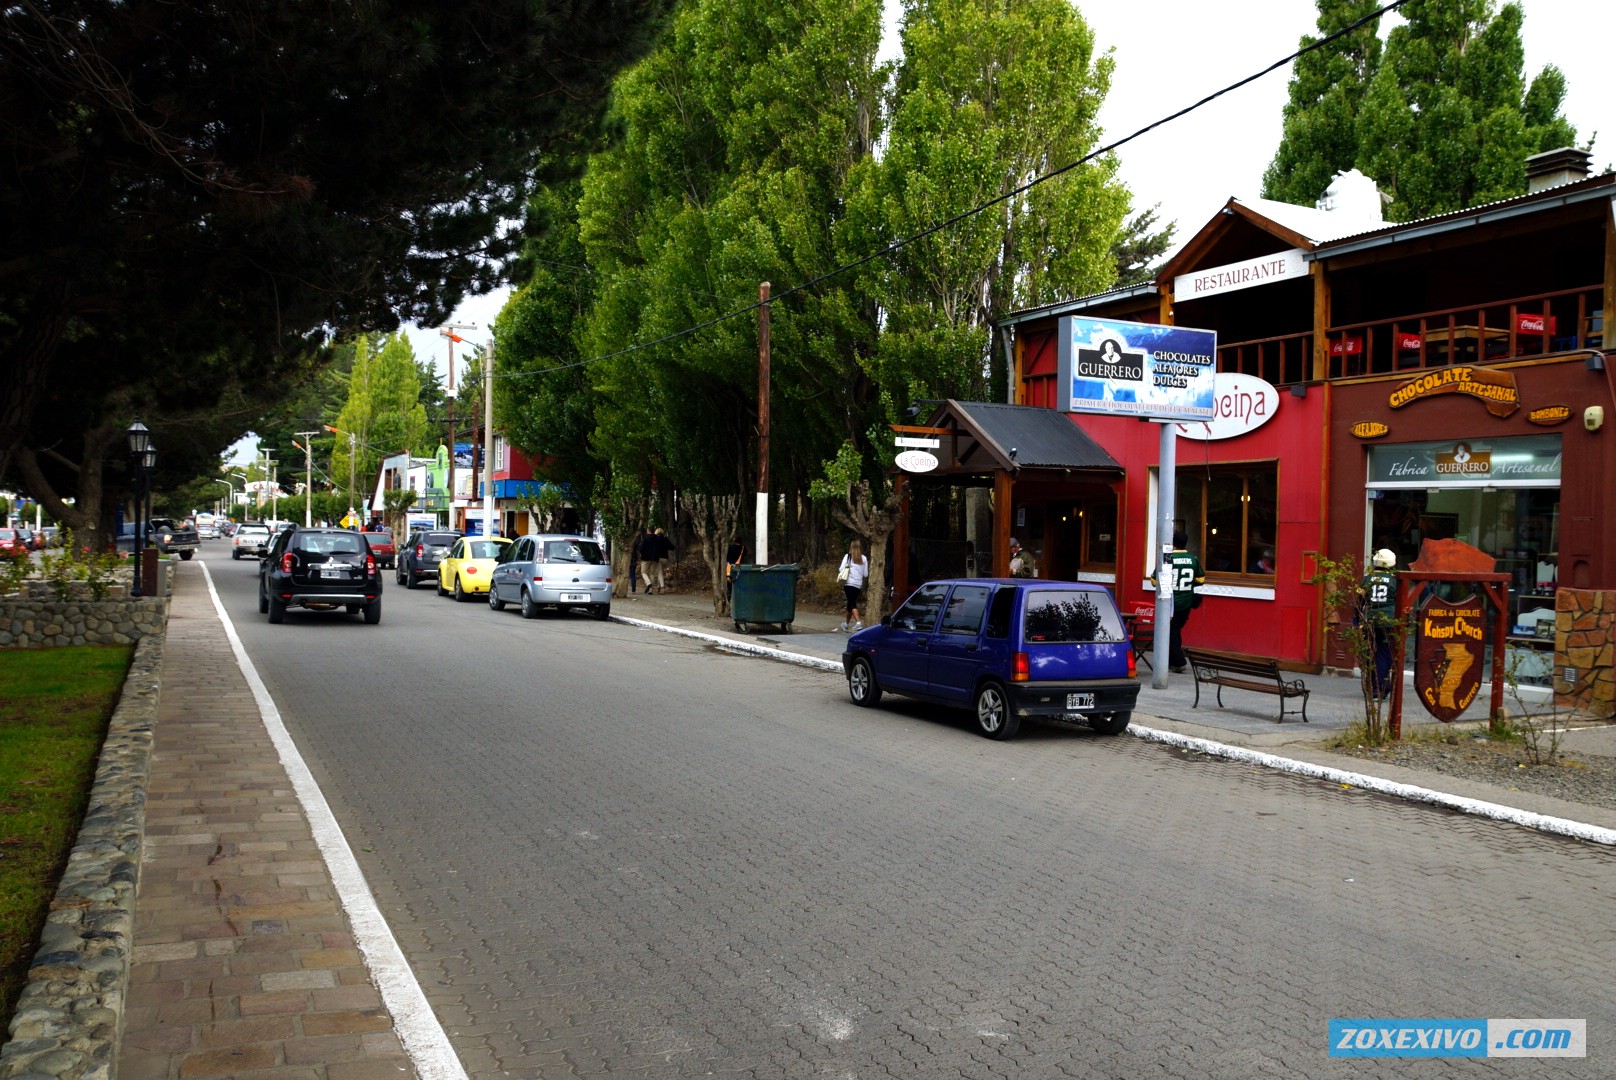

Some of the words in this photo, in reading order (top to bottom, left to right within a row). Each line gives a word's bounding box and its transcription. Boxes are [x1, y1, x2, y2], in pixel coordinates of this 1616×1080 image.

[1194, 259, 1286, 293] RESTAURANTE
[1153, 350, 1211, 365] CHOCOLATES
[1079, 362, 1142, 381] GUERRERO
[1153, 363, 1198, 376] ALFAJORES
[1153, 375, 1187, 387] DULCES
[1389, 367, 1473, 407] CHOCOLATE
[1458, 381, 1516, 402] ARTESANAL
[1530, 407, 1569, 420] BOMBONES
[1389, 456, 1429, 476] Fábrica
[1436, 462, 1489, 474] GUERRERO
[1491, 451, 1562, 475] Artesanal
[1370, 584, 1388, 602] 12
